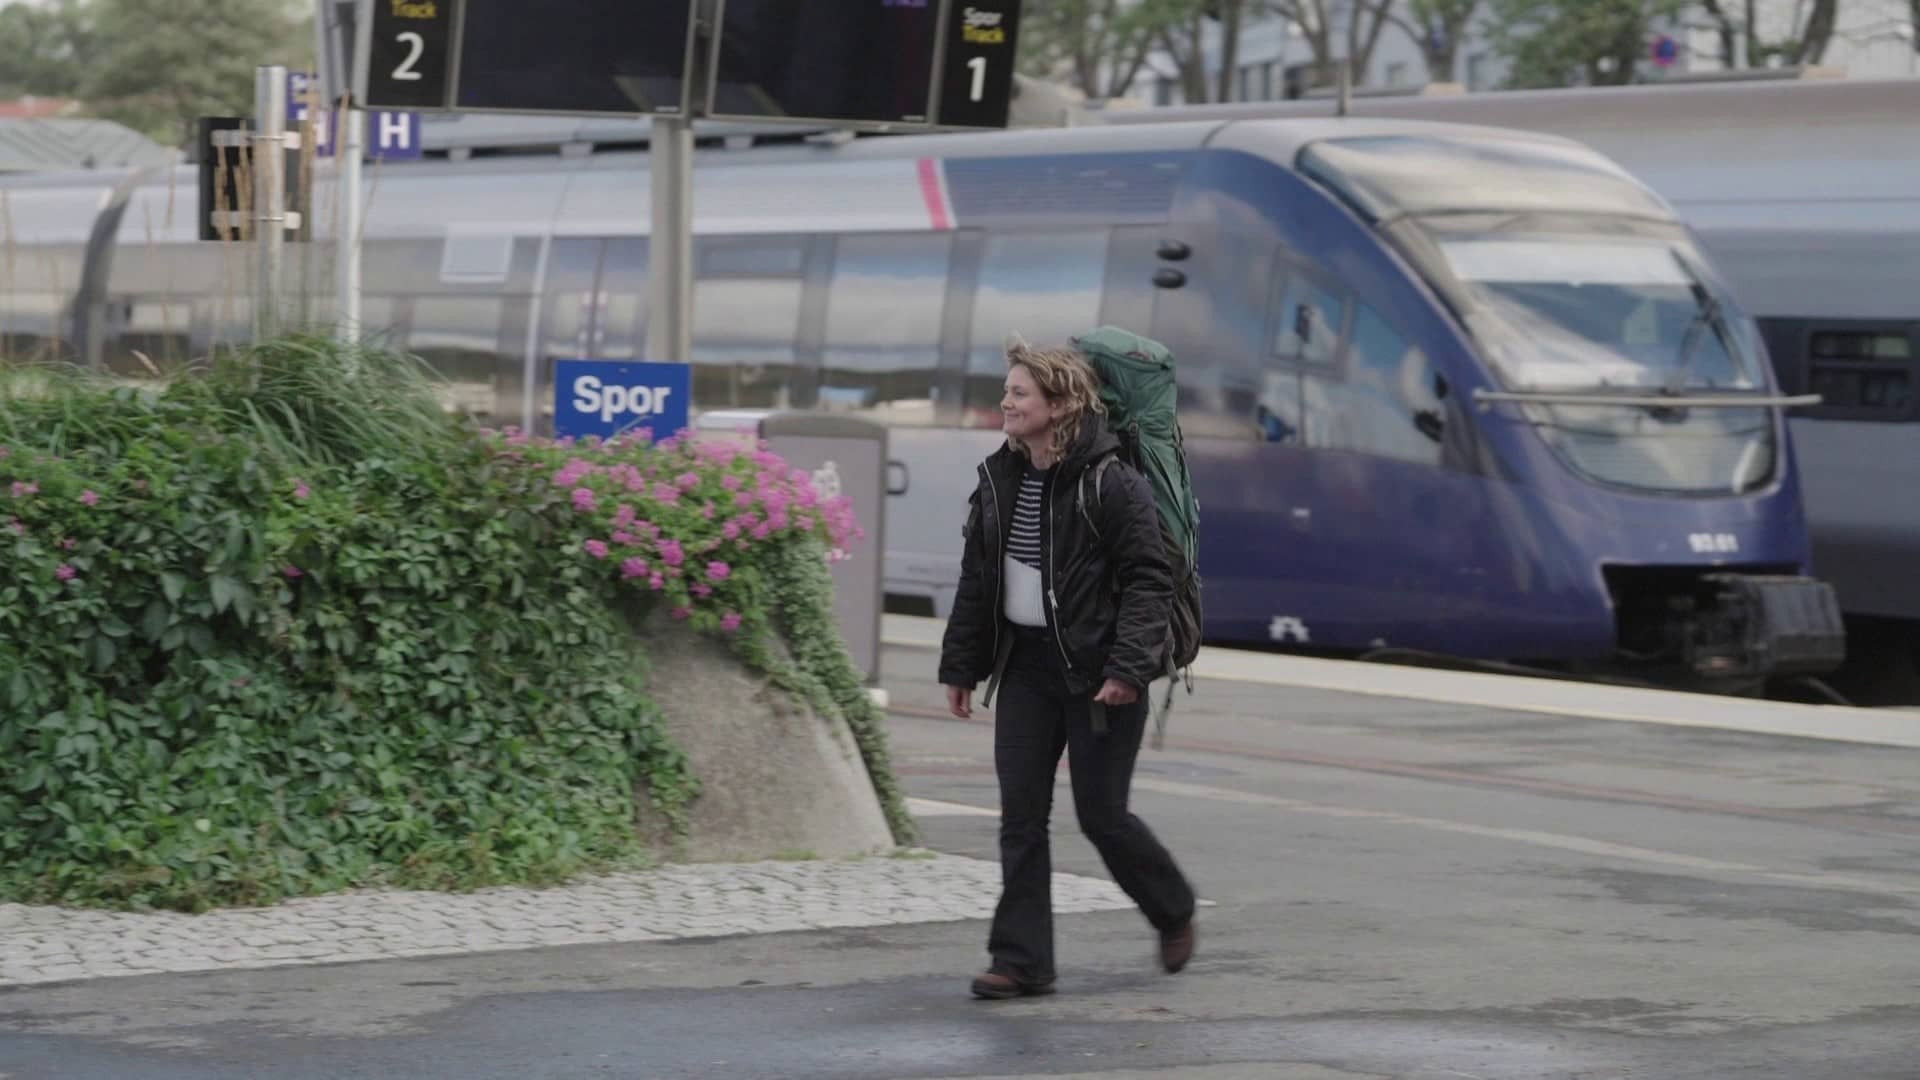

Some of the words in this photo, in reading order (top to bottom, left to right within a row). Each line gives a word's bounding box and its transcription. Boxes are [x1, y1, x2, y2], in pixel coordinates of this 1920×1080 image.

[963, 7, 1003, 27] Spor
[963, 25, 1004, 43] Track
[391, 31, 424, 80] 2
[967, 56, 987, 102] 1
[380, 111, 410, 149] H
[573, 375, 671, 422] Spor
